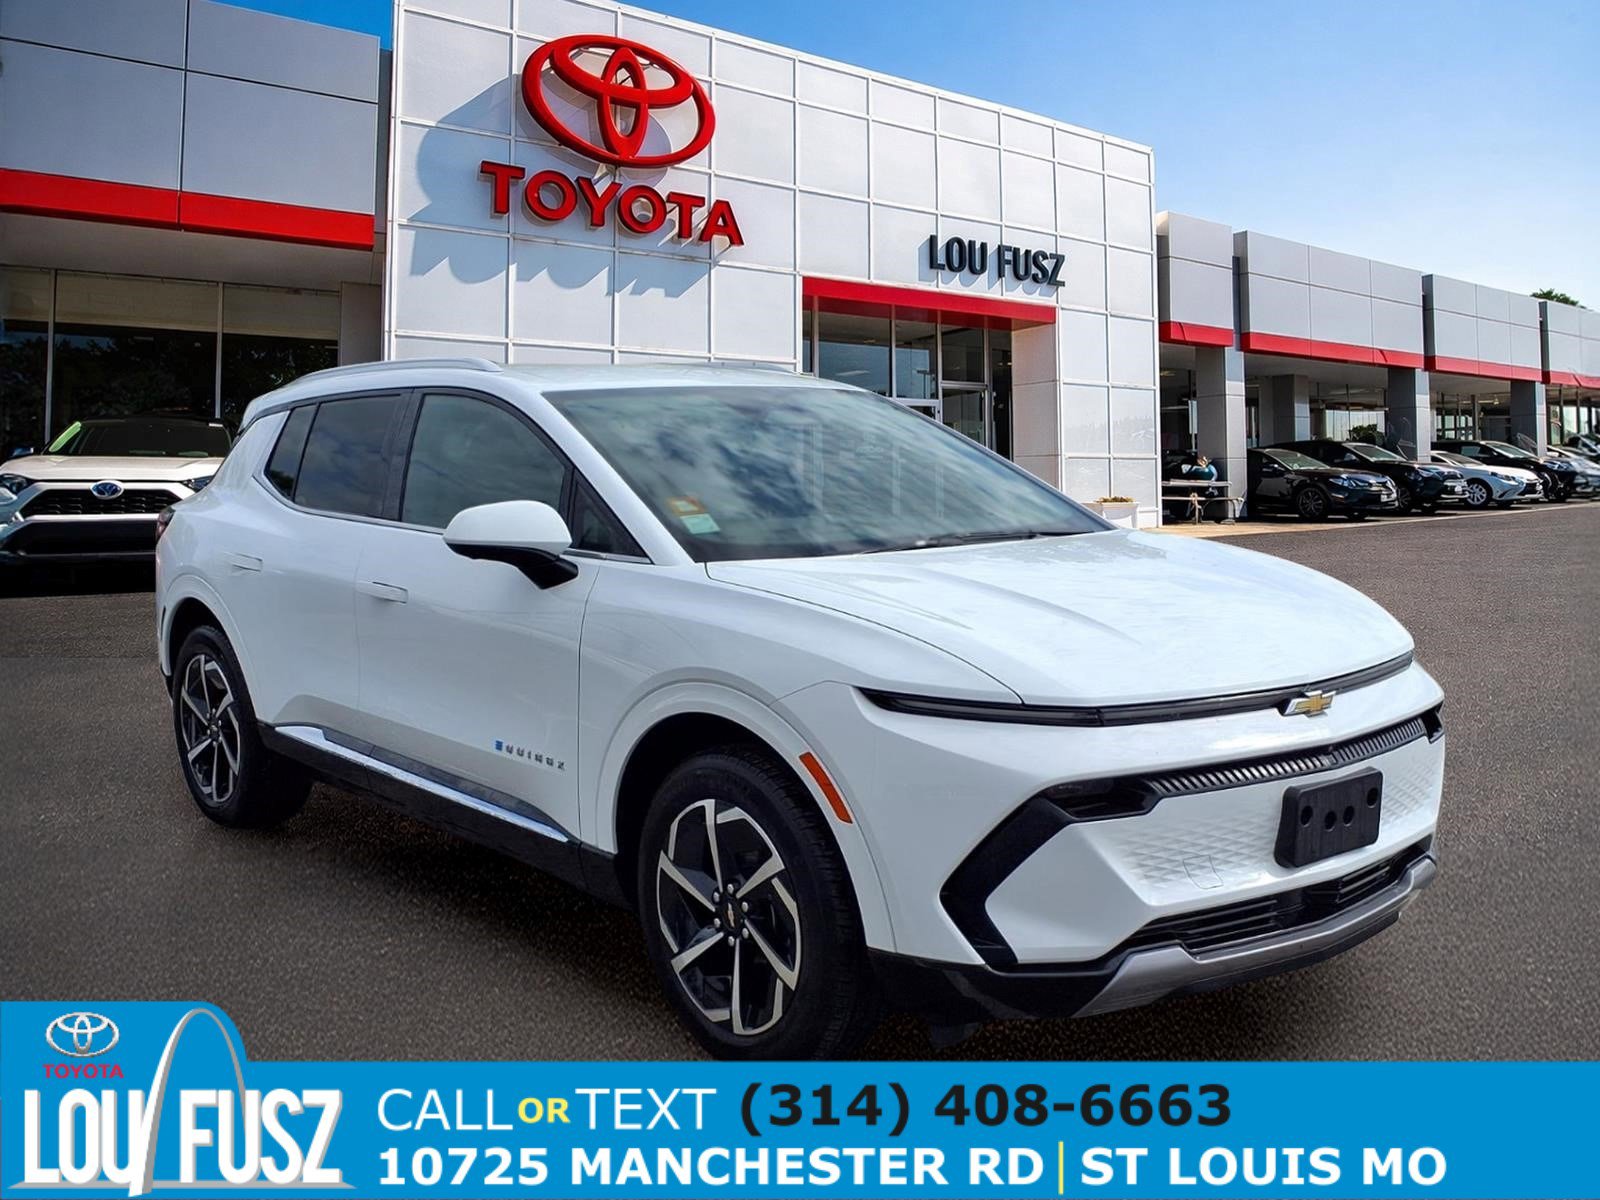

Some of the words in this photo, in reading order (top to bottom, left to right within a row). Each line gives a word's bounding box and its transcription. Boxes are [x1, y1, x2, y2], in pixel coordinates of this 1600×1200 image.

[479, 159, 744, 246] TOYOTA
[928, 234, 988, 276] LOU
[997, 244, 1066, 288] FUSZ
